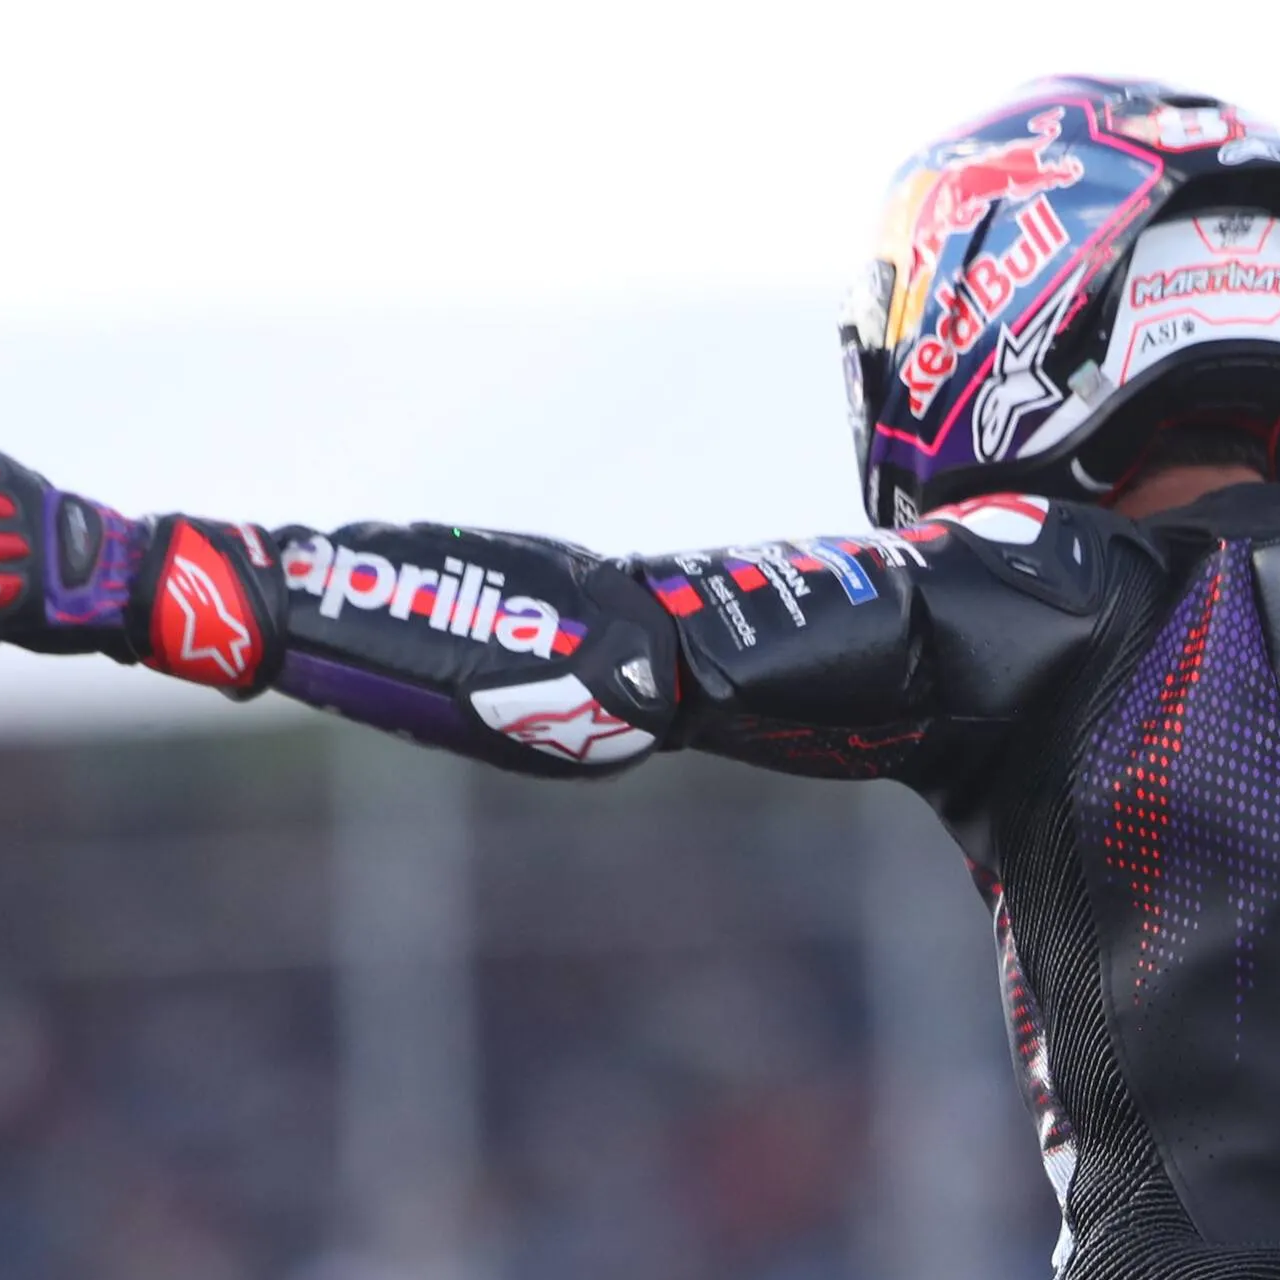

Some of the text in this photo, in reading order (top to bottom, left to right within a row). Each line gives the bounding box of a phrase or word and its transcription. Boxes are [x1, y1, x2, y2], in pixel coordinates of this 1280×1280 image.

[898, 278, 982, 420] Red
[968, 198, 1070, 322] Bull
[282, 536, 559, 659] aprilia
